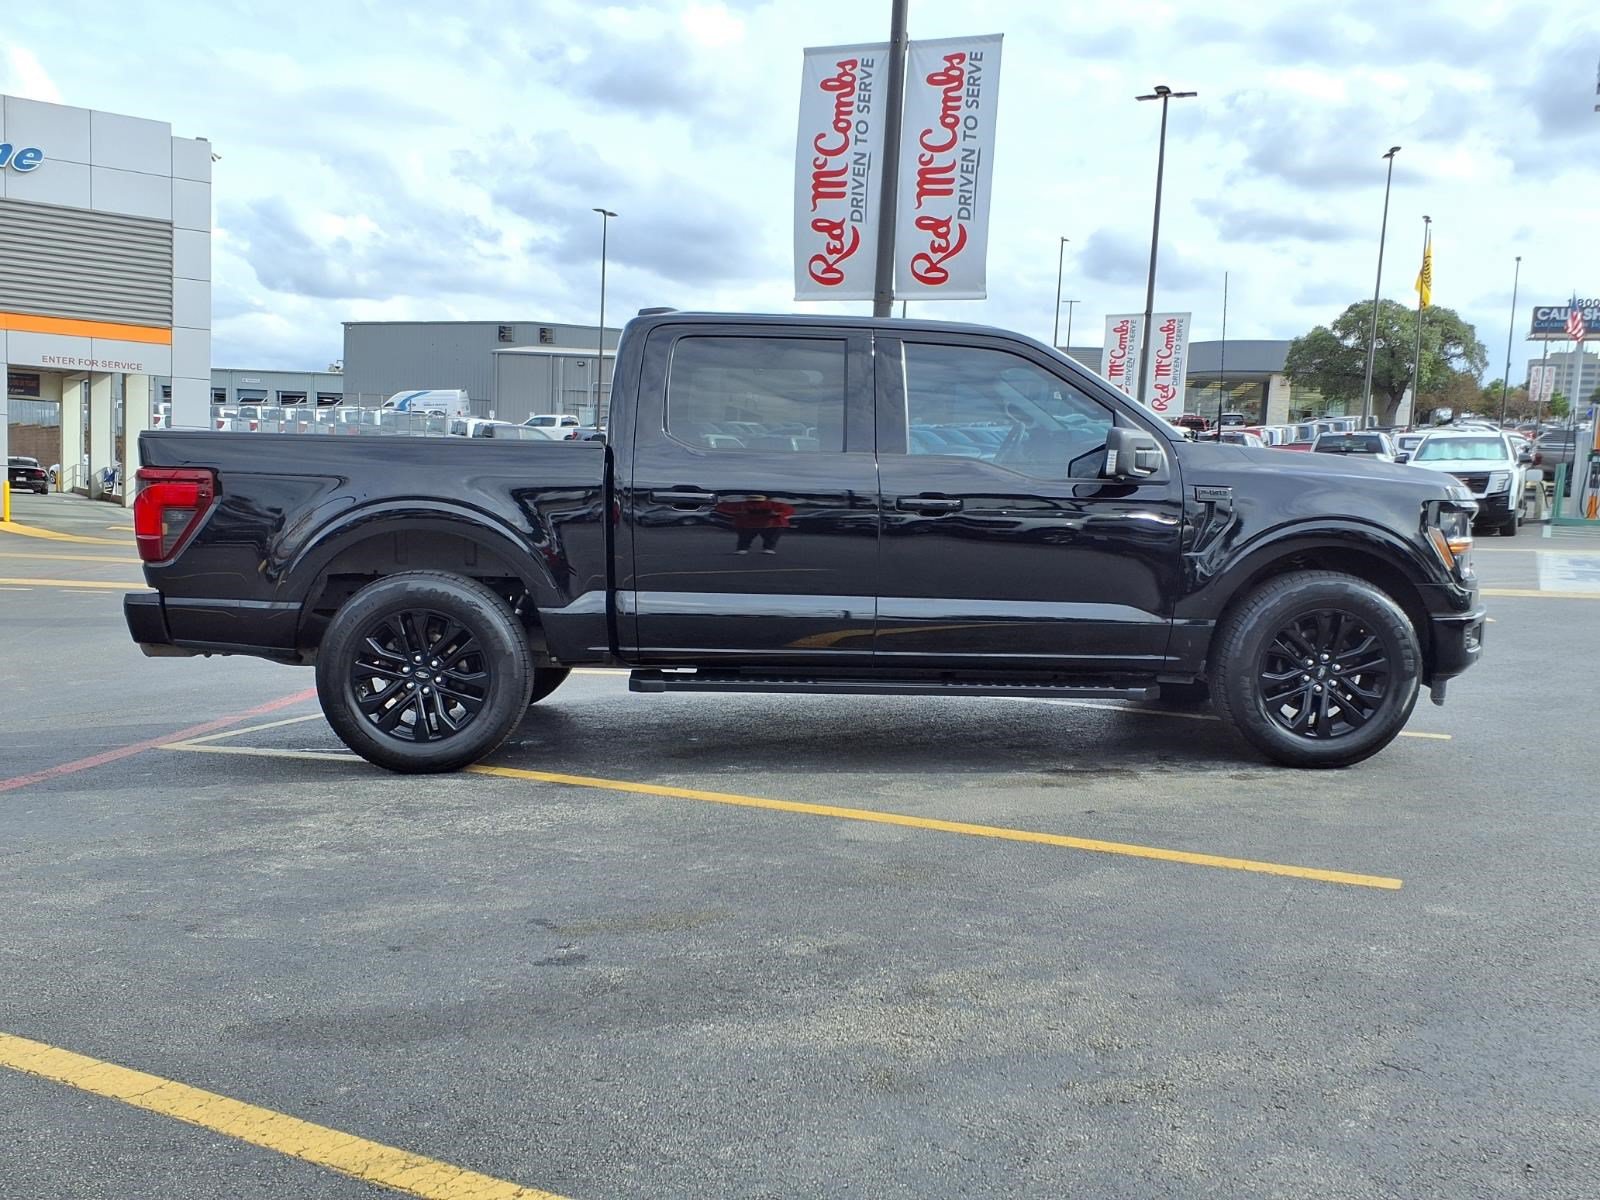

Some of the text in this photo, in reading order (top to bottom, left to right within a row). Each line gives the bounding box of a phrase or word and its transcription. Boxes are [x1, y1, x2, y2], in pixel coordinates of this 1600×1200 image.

[808, 58, 860, 286] Red McCombs
[851, 57, 874, 223] DRIVEN TO SERVE
[911, 52, 967, 285] Red McCombs
[957, 51, 984, 221] DRIVEN TO SERVE
[42, 355, 143, 371] ENTER FOR SERVICE
[1109, 320, 1129, 380] McCombs
[1125, 320, 1137, 386] DRIVEN TO SERVE
[1151, 319, 1176, 411] Red McCombs
[1172, 319, 1184, 386] DRIVEN TO SERVE
